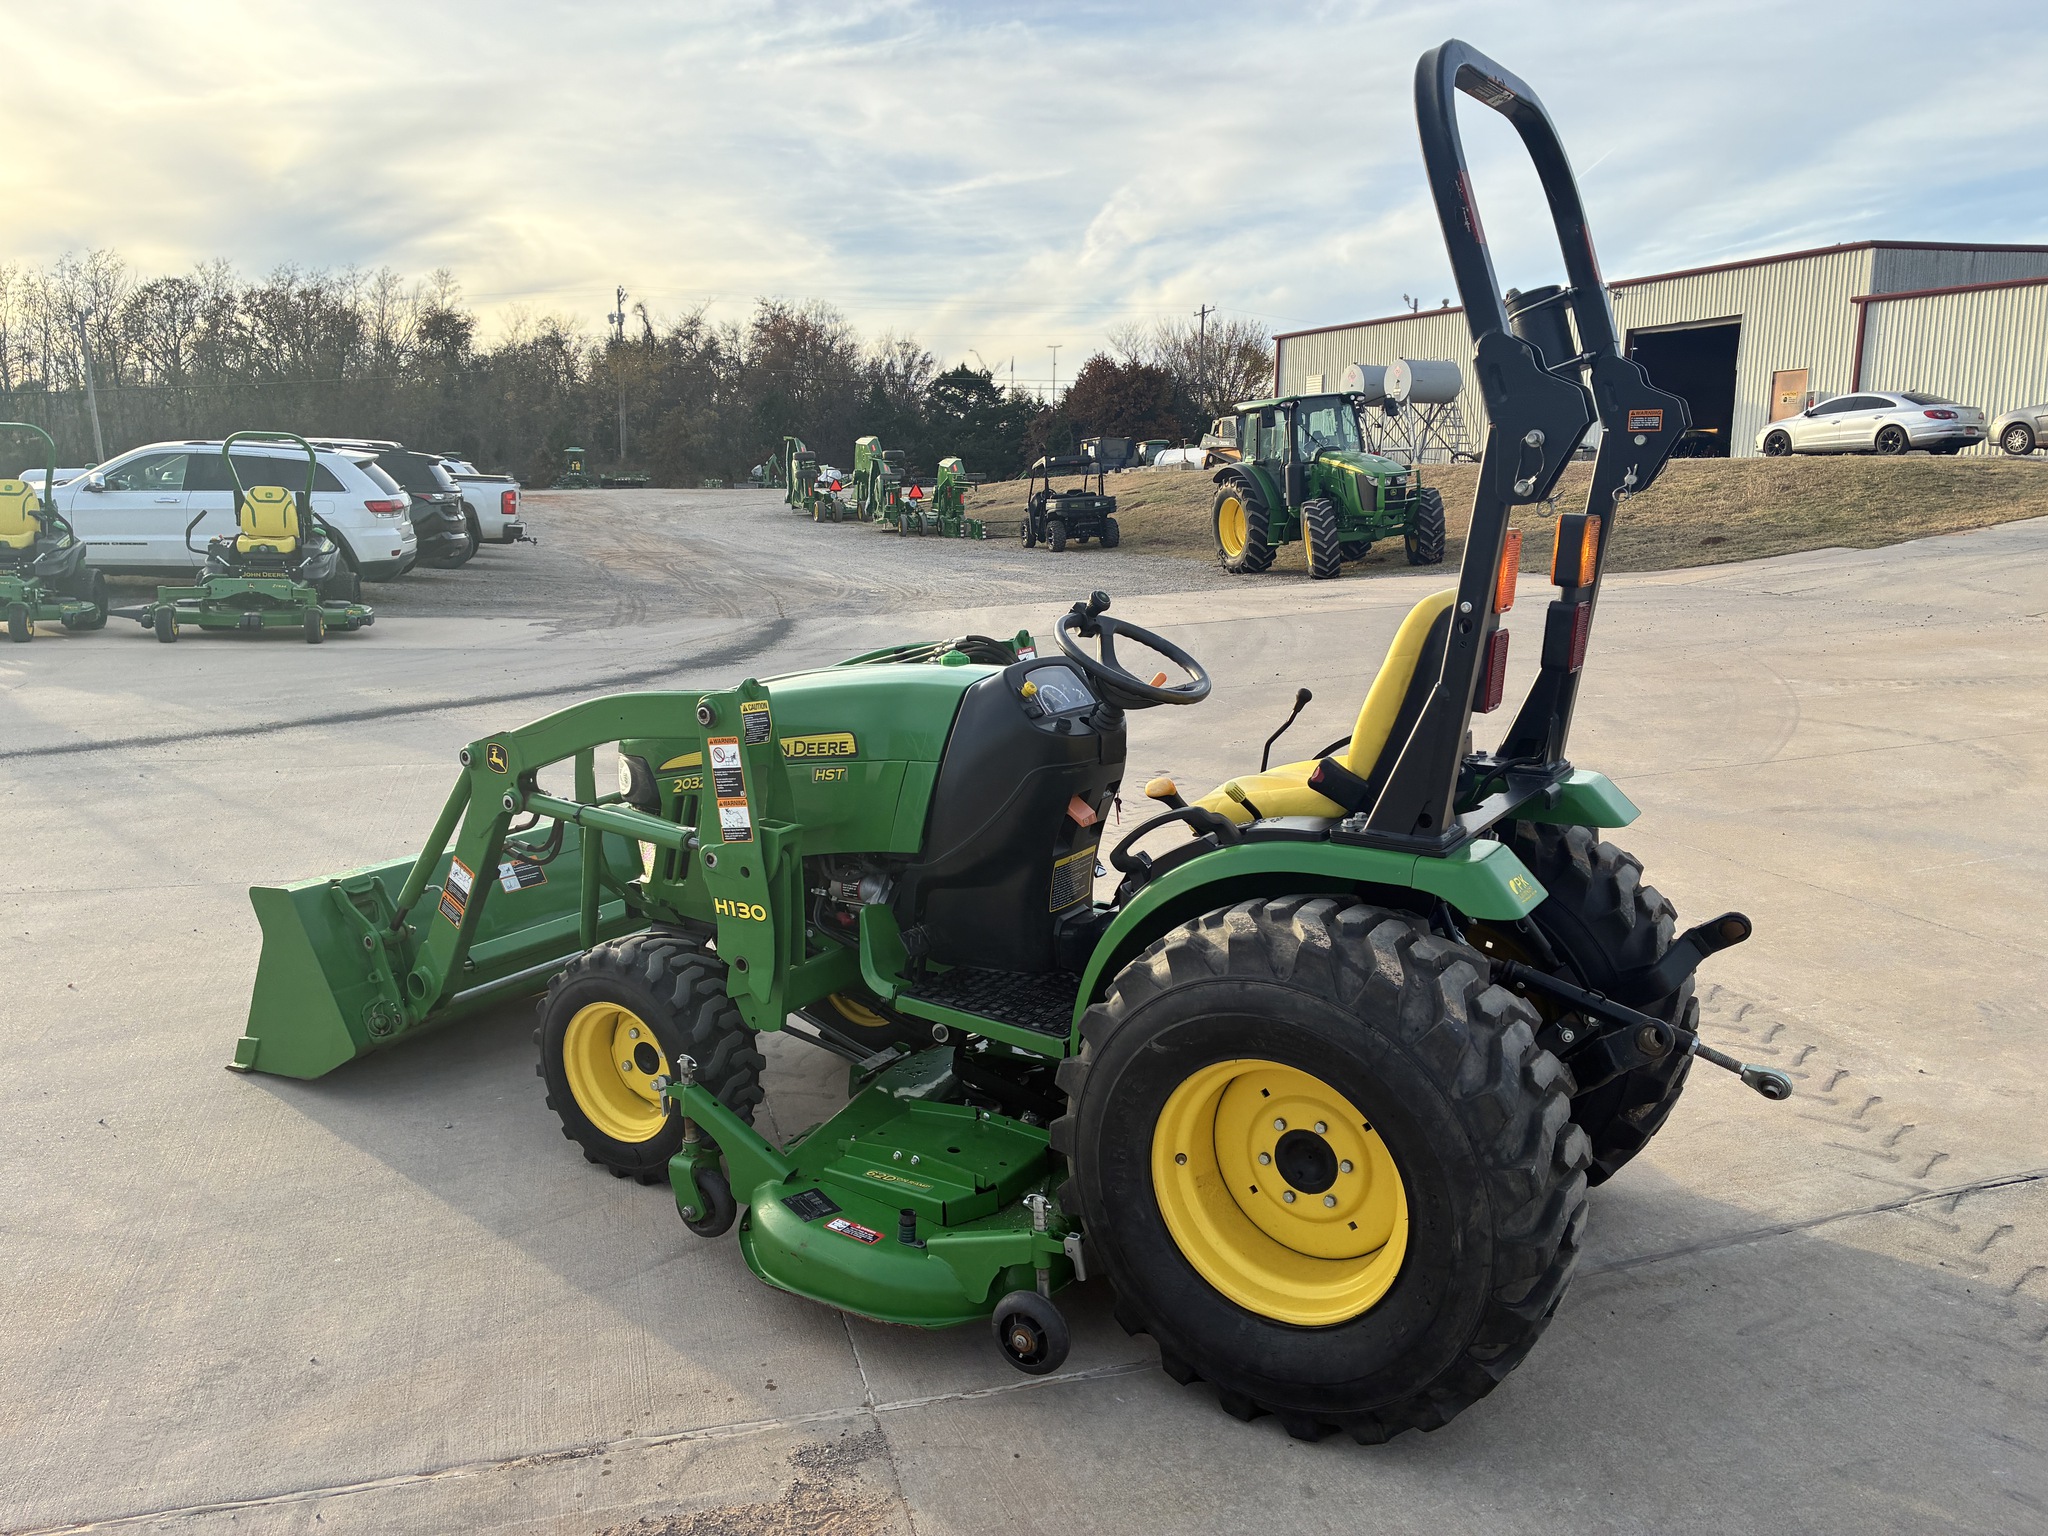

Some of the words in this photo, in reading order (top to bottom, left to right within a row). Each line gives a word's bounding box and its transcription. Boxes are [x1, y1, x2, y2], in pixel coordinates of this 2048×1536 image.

[748, 702, 768, 711] CAUTION
[794, 740, 849, 756] DEERE
[815, 767, 845, 781] HST
[713, 896, 768, 922] H130
